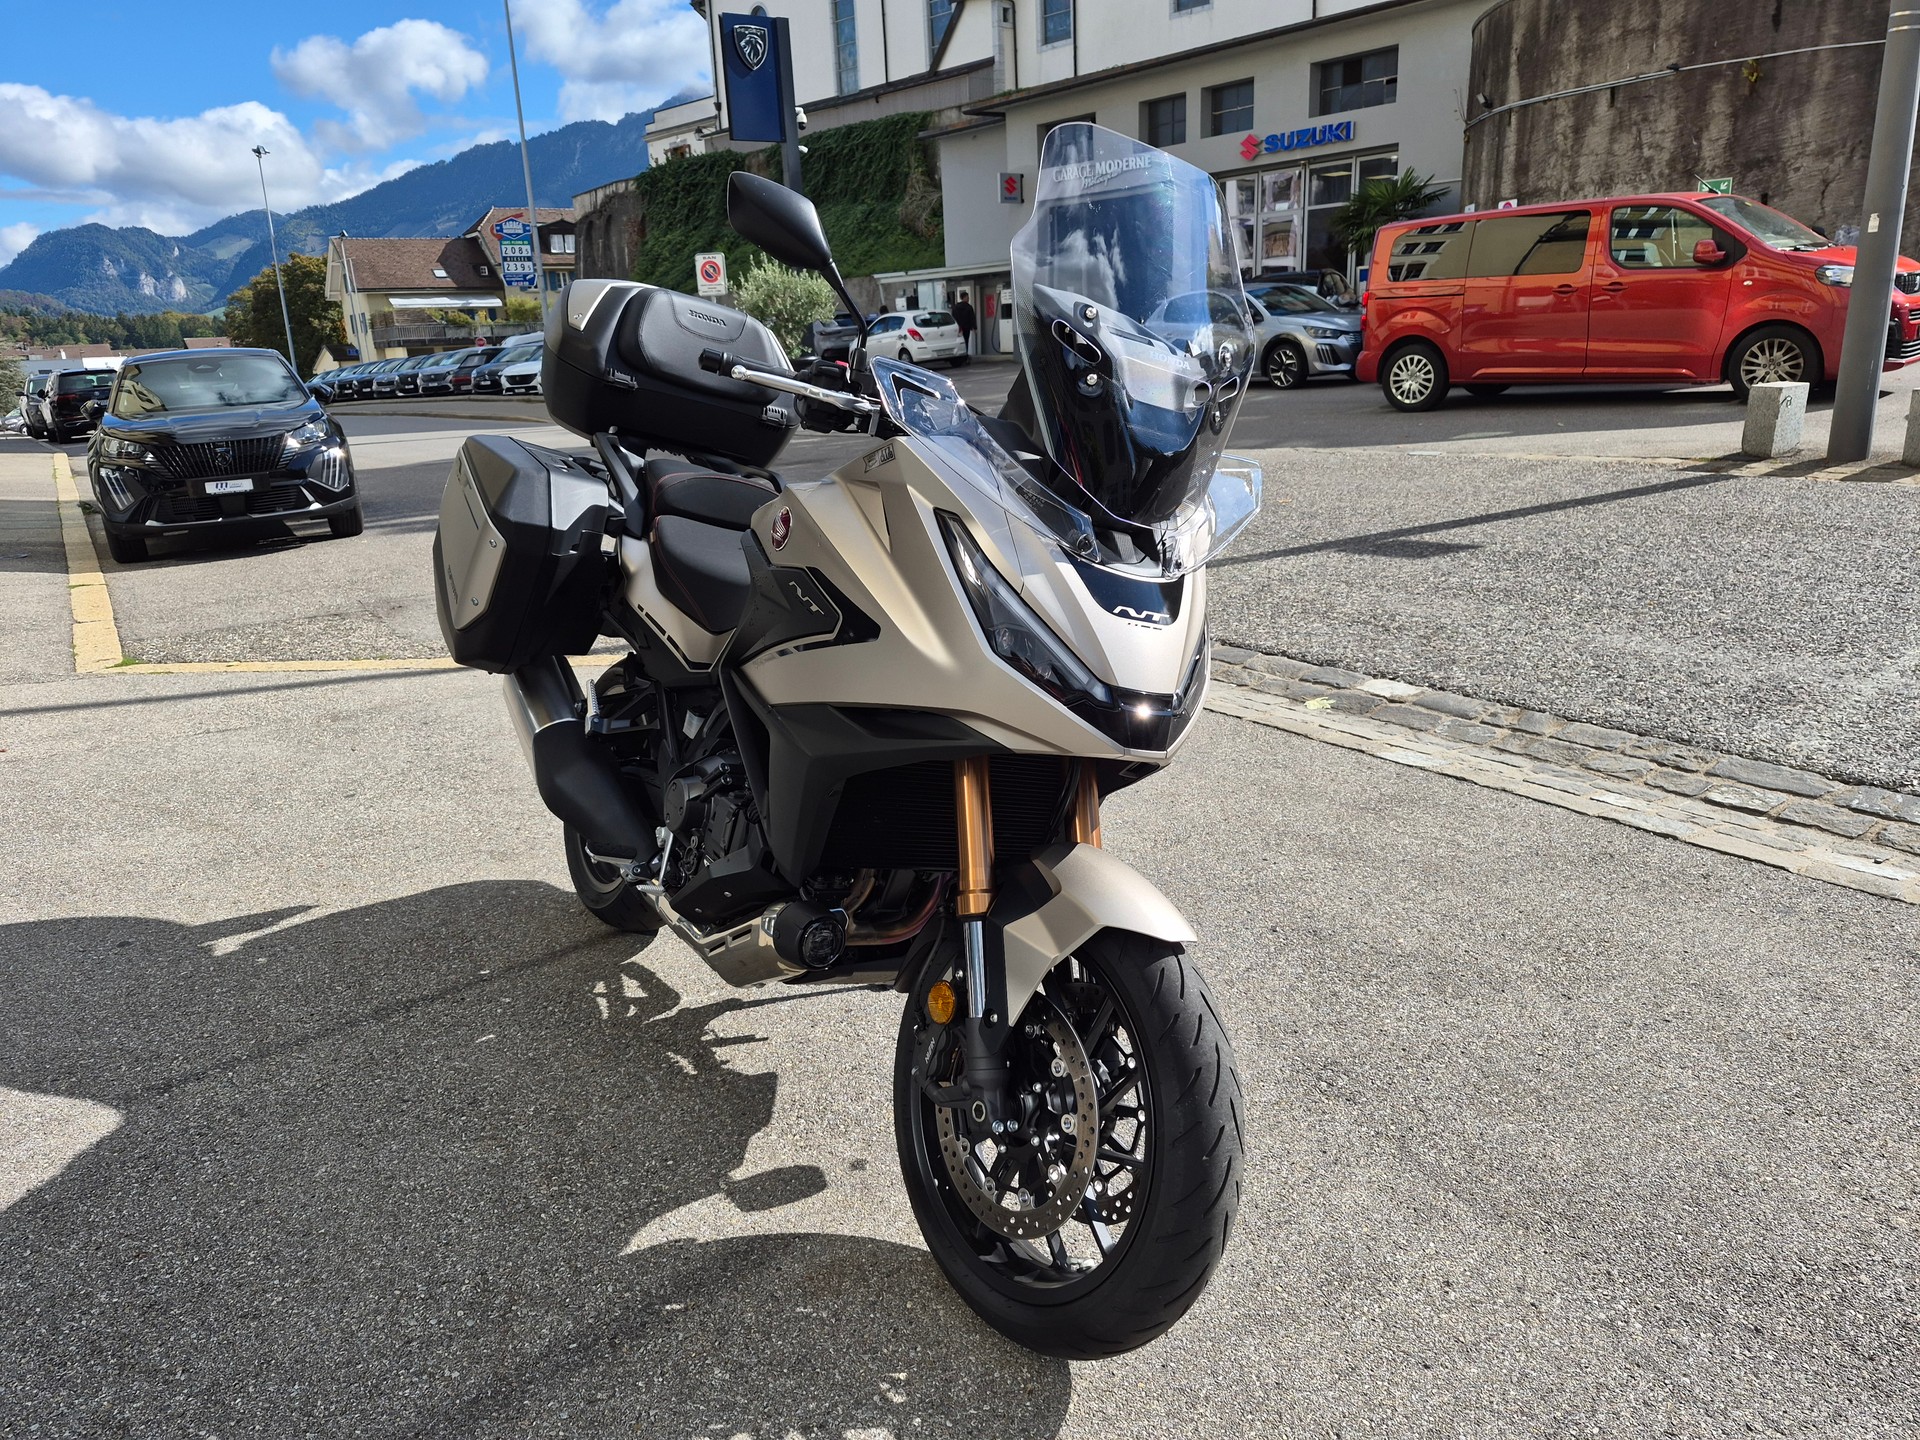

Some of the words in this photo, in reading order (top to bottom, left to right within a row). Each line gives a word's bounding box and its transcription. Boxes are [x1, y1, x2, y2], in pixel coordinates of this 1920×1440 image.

[1264, 121, 1355, 153] SUZUKI
[1053, 164, 1093, 182] GARAGE
[1095, 155, 1152, 174] MODERNE
[688, 309, 727, 328] HONDA
[1149, 350, 1191, 370] HONDA
[1112, 605, 1170, 622] NT
